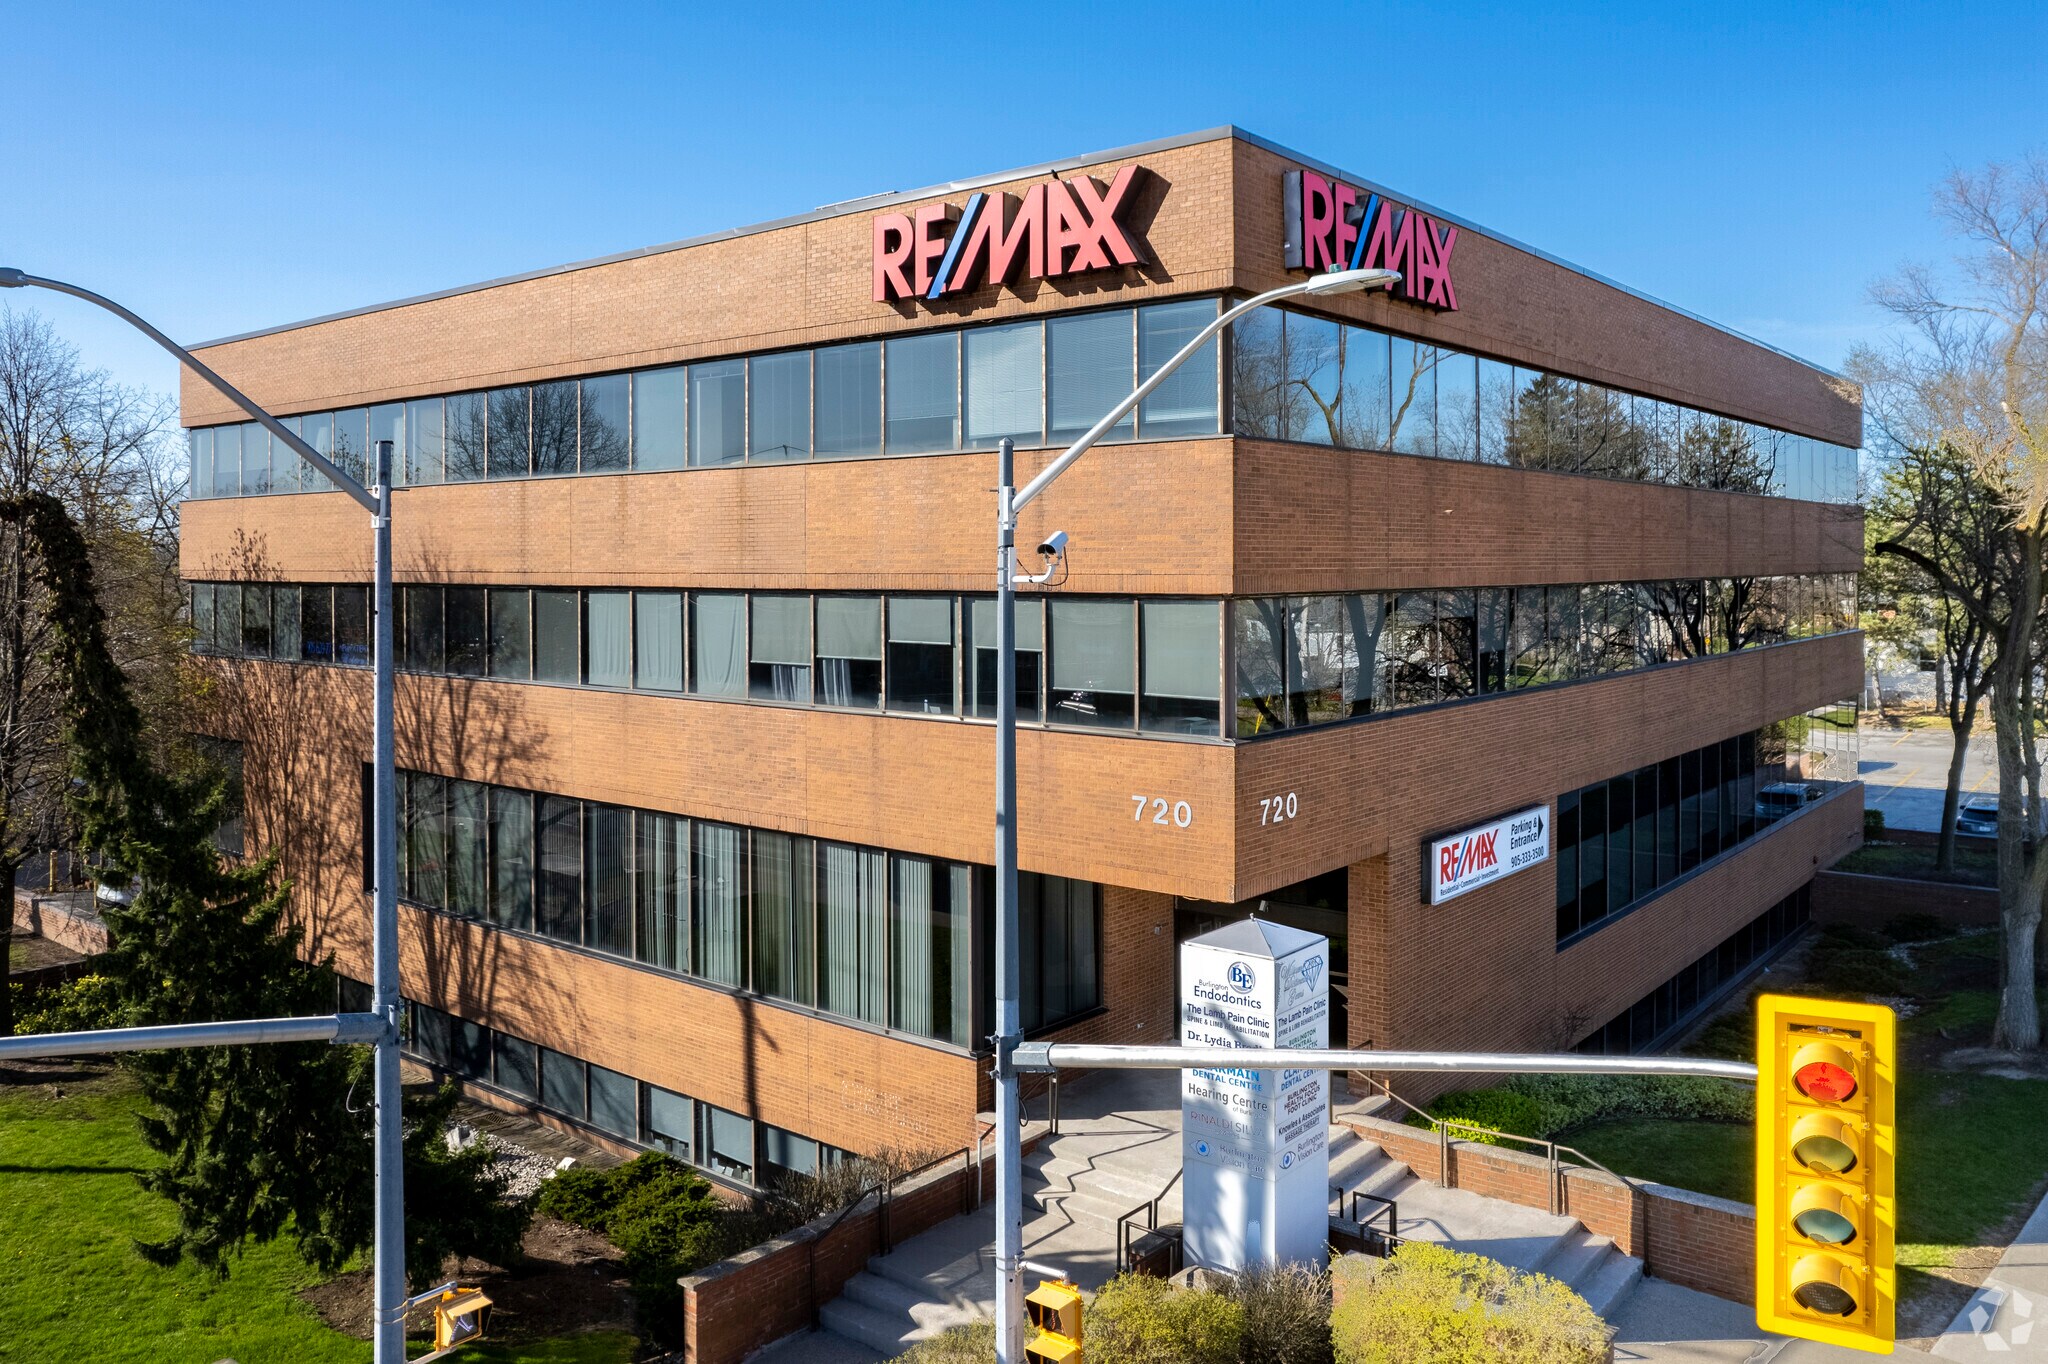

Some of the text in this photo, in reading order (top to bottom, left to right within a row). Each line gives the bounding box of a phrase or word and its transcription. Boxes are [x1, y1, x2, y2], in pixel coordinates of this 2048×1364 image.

[873, 164, 1139, 302] RE/MAX
[1303, 170, 1460, 311] RE/MAX
[1131, 795, 1193, 828] 720
[1260, 792, 1298, 826] 720
[1511, 817, 1537, 836] Parking &
[1510, 832, 1537, 850] Entrance
[1440, 828, 1499, 885] RE/MAX
[1510, 846, 1545, 868] 905-333-3500
[1199, 979, 1228, 991] Burlington
[1194, 985, 1262, 1009] Endodontics
[1187, 1003, 1270, 1029] The Lamb Pain Clinic
[1278, 1017, 1288, 1028] The
[1288, 1010, 1302, 1023] Lamb
[1302, 1004, 1313, 1016] Pain
[1313, 998, 1326, 1011] Clinic
[1187, 1015, 1202, 1025] SPINE
[1210, 1020, 1223, 1028] LIMB
[1224, 1023, 1270, 1038] REHABILITATION
[1278, 1028, 1288, 1038] SPINE
[1289, 1027, 1316, 1047] BURLINGTON
[1187, 1030, 1202, 1041] Dr.
[1204, 1034, 1232, 1048] Lydia
[1192, 1069, 1263, 1092] DENTAL CENTRE
[1281, 1074, 1302, 1091] DENTAL
[1287, 1080, 1318, 1101] BURLINGTON
[1188, 1083, 1268, 1112] Hearing Centre
[1284, 1084, 1321, 1110] HEALTH FOCUS
[1287, 1093, 1317, 1115] FOOT CLINIC
[1278, 1119, 1298, 1136] Knowles
[1302, 1103, 1326, 1122] Associates
[1285, 1117, 1320, 1142] MASSAGE THERAPY
[1297, 1131, 1324, 1152] Burlington
[1297, 1141, 1324, 1161] Vision Care
